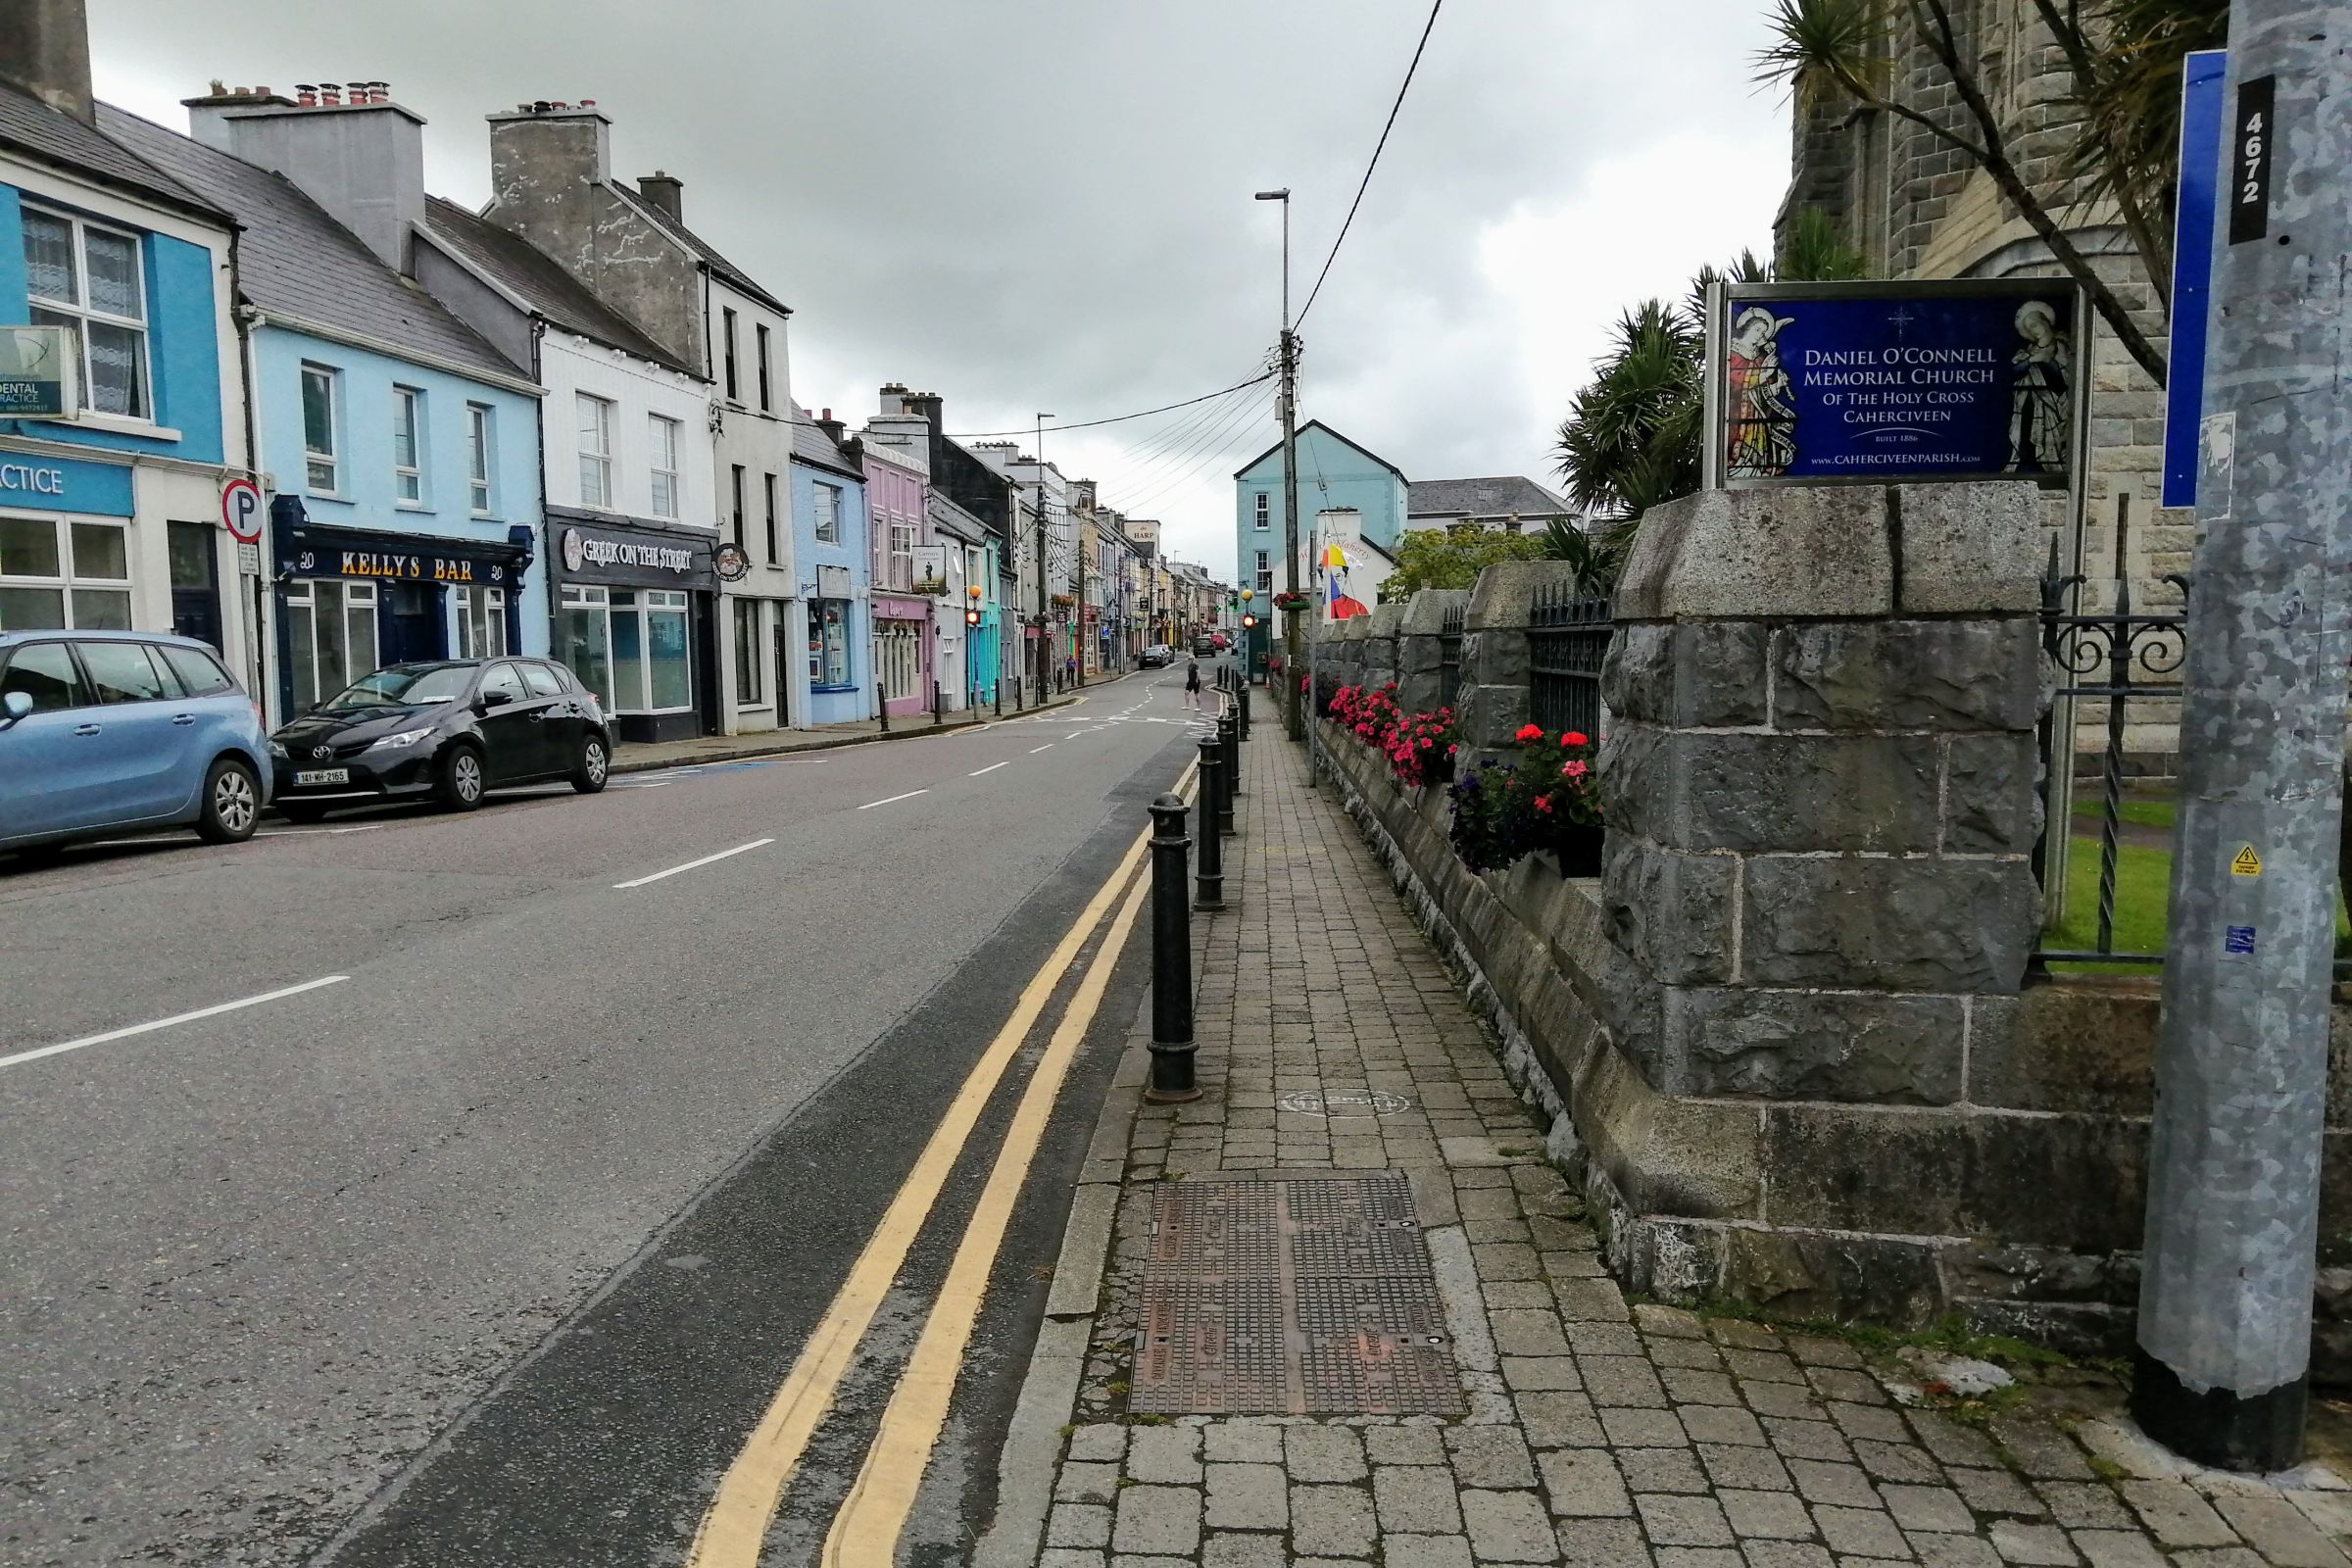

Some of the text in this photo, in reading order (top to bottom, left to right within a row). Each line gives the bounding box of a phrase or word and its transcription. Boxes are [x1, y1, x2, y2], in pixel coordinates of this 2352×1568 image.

[2242, 113, 2263, 204] 4672
[1805, 347, 1997, 367] DANIEL O'CONNELL
[1804, 368, 1994, 386] MEMORIAL CHURCH
[1847, 392, 1878, 405] THE
[1883, 392, 1923, 405] HOLY
[1927, 391, 1975, 404] CROSS
[1843, 410, 1951, 423] CAHERCIVEEN
[0, 464, 64, 494] CTICE
[237, 491, 255, 529] P
[300, 552, 314, 569] 20
[434, 558, 472, 581] BAR
[491, 564, 503, 580] 20
[583, 539, 692, 573] GREEK ON THE STREET
